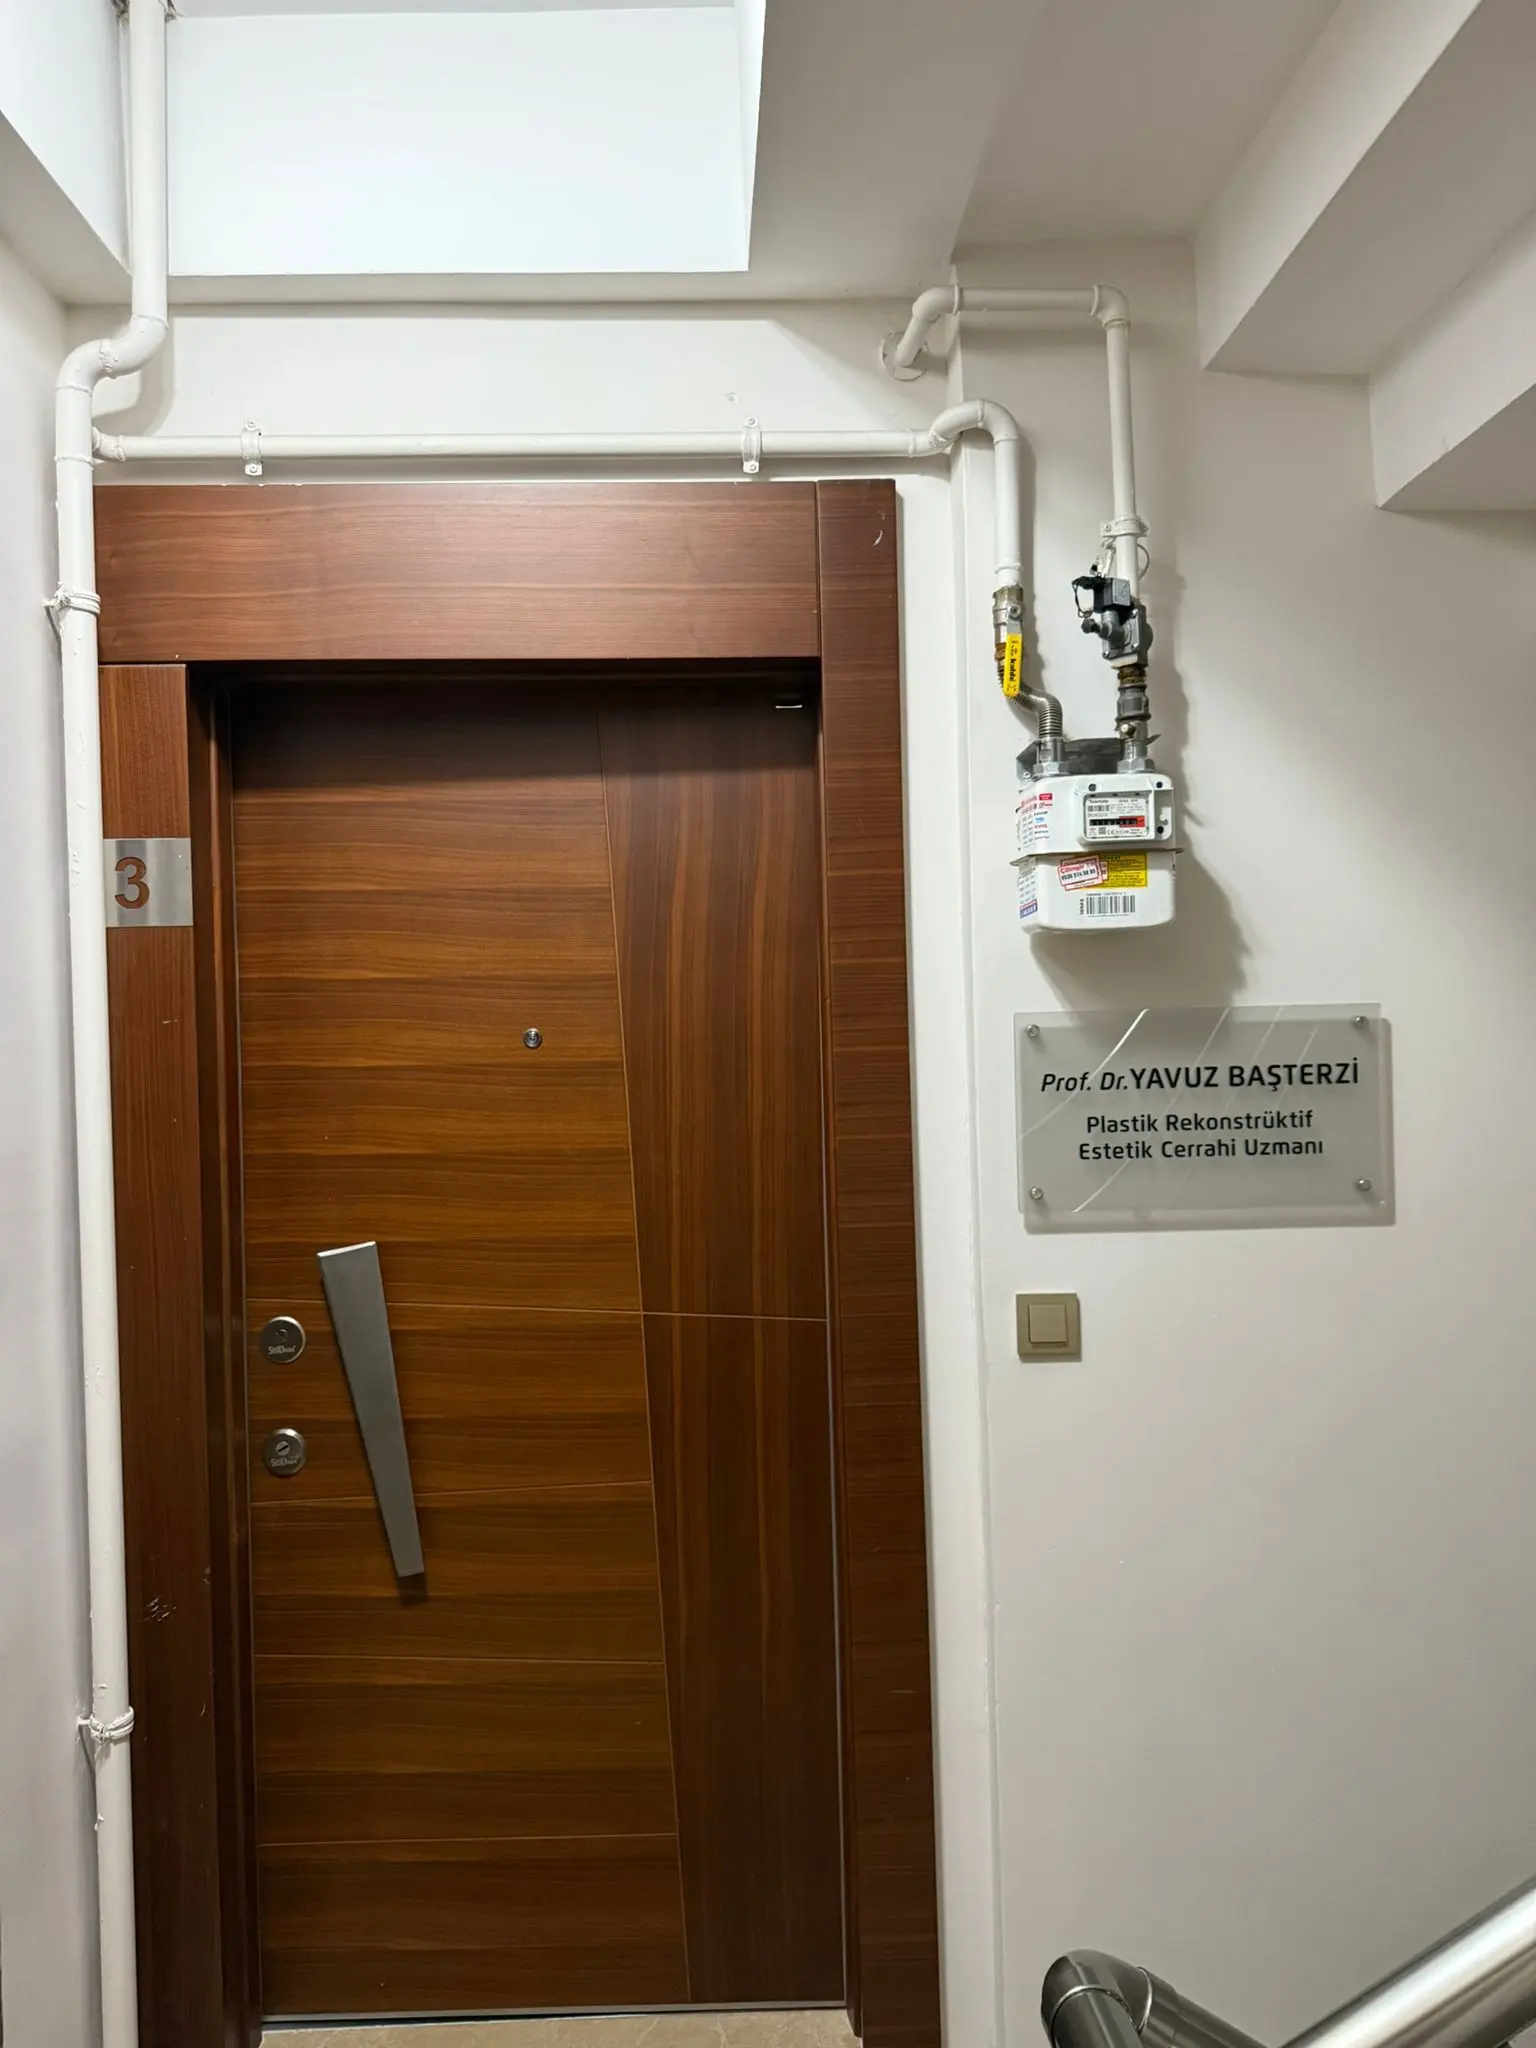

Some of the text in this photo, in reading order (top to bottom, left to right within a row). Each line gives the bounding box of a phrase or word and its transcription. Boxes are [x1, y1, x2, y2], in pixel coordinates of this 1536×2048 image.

[114, 856, 150, 910] 3
[1041, 1071, 1092, 1092] Prof.
[1229, 1057, 1359, 1092] BAŞTERZİ
[1087, 1110, 1313, 1133] Plastik Rekonstrüktif
[1079, 1138, 1323, 1160] Estetik Cerrahi Uzmanı
